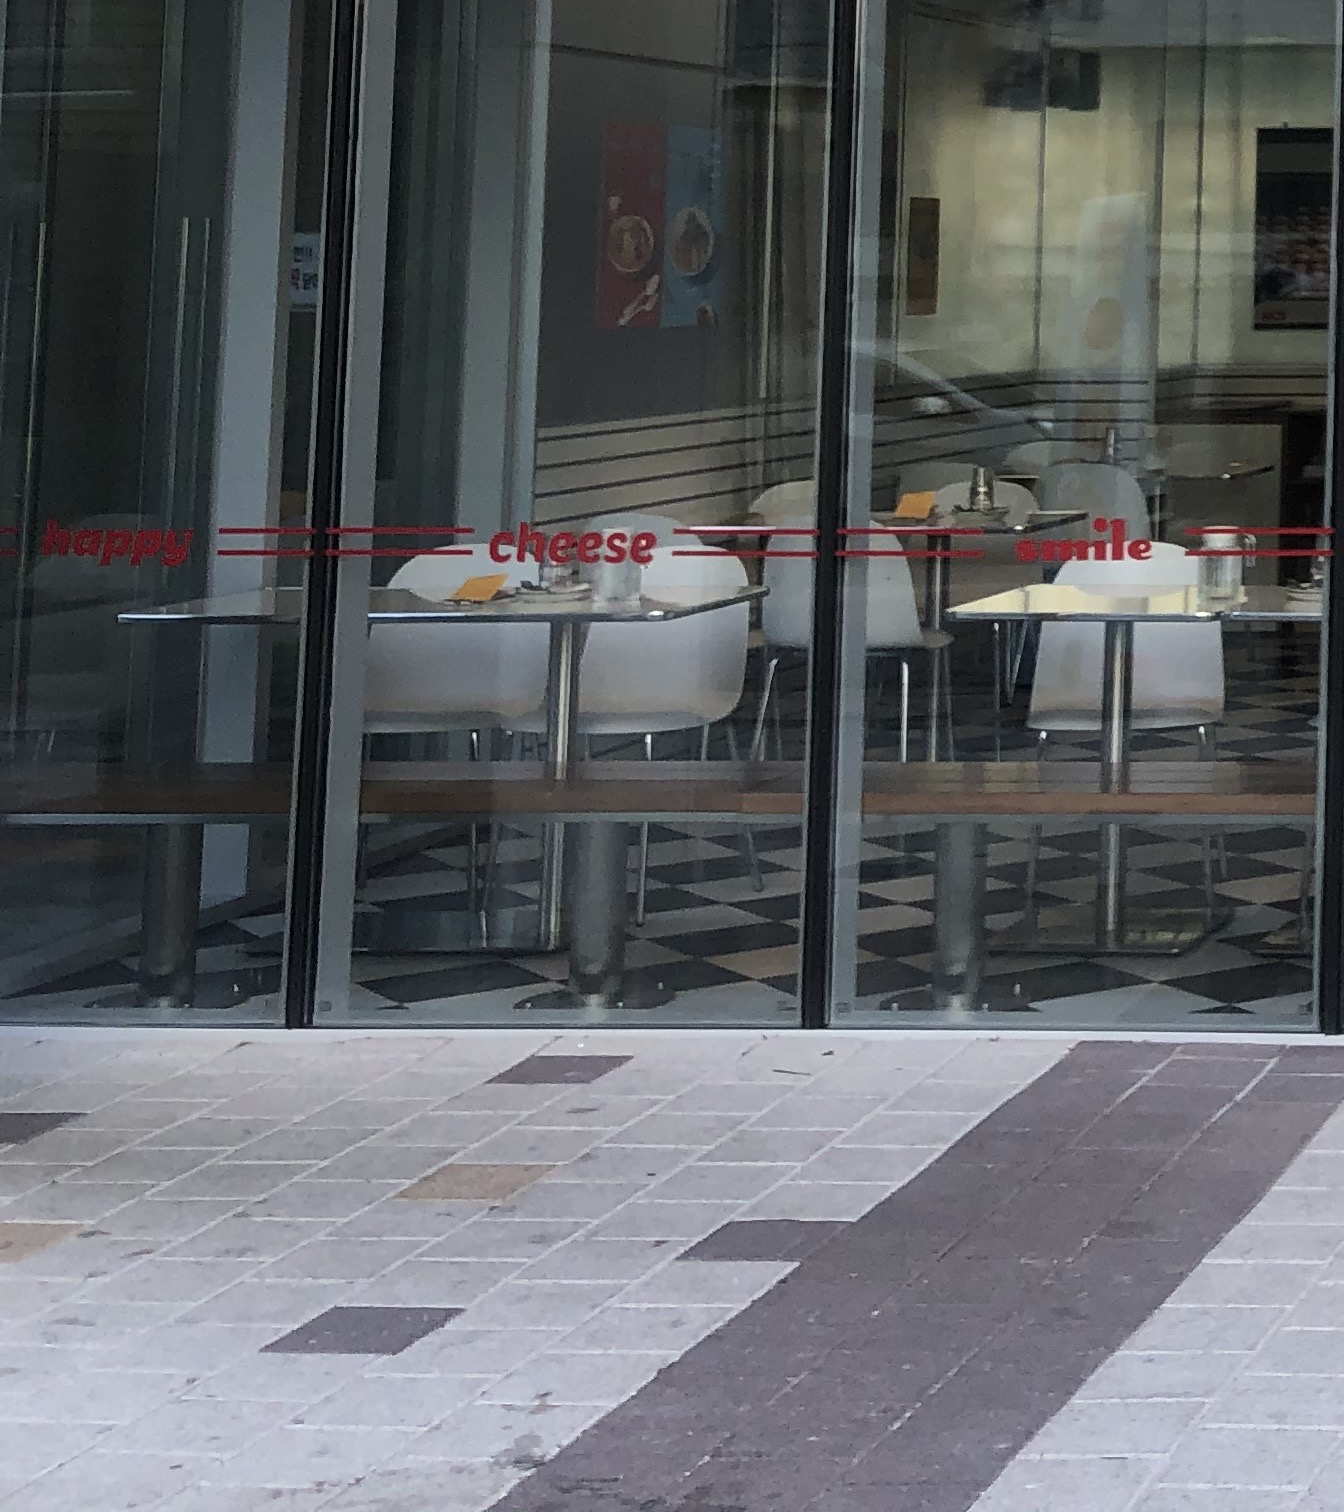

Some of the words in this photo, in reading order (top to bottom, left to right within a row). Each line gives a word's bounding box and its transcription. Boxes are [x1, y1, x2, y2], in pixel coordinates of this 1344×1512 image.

[42, 518, 194, 567] happy
[488, 521, 658, 565] cheese
[1015, 517, 1153, 563] smile
